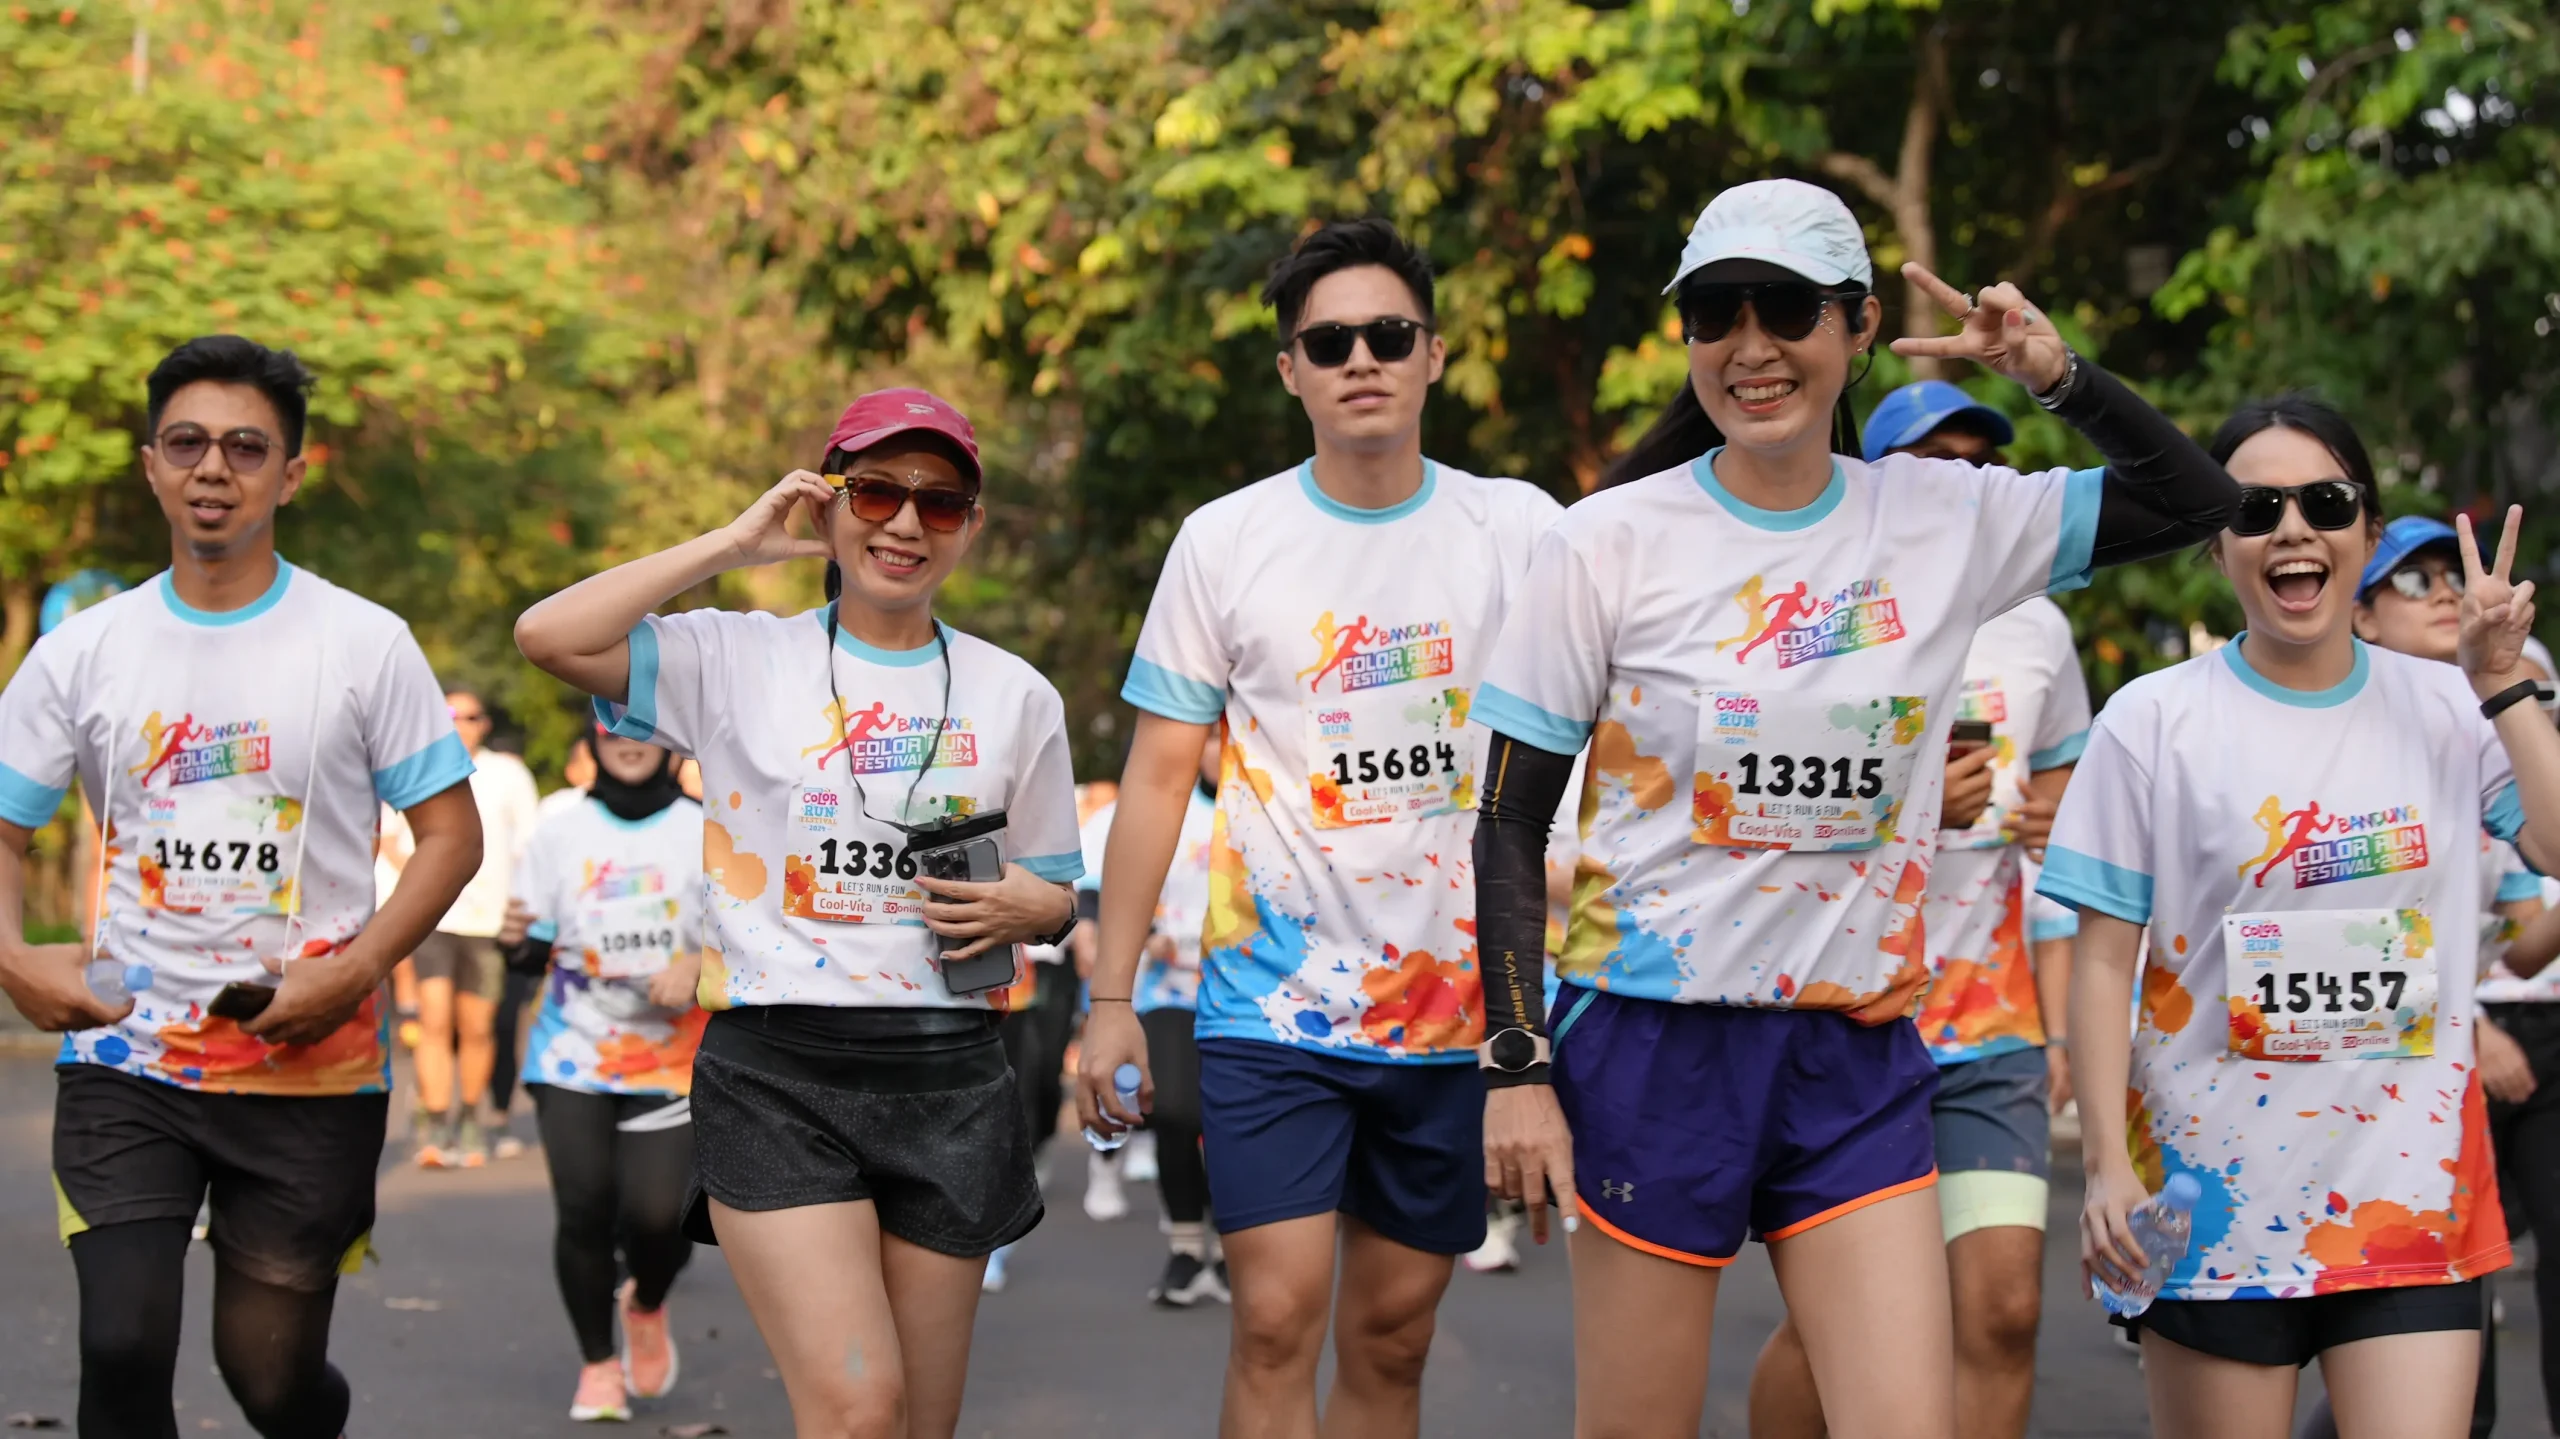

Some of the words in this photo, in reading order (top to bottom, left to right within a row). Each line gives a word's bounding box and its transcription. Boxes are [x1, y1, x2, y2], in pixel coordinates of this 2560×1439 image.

[1821, 578, 1891, 615] BANDUNG
[1379, 619, 1451, 646] BANDUNG
[1777, 611, 1851, 650] COLOR
[1852, 602, 1893, 628] RUN
[1342, 649, 1402, 675] COLOR
[1408, 641, 1448, 663] RUN
[1343, 667, 1408, 689] FESTIVAL
[1411, 659, 1449, 676] 2024
[170, 744, 225, 770] COLOR
[229, 738, 267, 758] RUN
[853, 738, 921, 757] COLOR
[855, 754, 923, 770] FESTIVAL
[1332, 741, 1455, 785] 15684
[1738, 752, 1884, 799] 13315
[803, 792, 838, 805] COLOR
[803, 805, 834, 817] RUN
[1738, 822, 1802, 838] Cool-Vita
[2338, 804, 2418, 834] BANDUNG
[155, 838, 279, 872] 14678
[820, 838, 917, 880] 1336
[2294, 838, 2368, 866] COLOR
[2375, 828, 2423, 853] RUN
[2297, 858, 2376, 883] FESTIVAL
[2380, 848, 2426, 868] 2024
[843, 882, 864, 892] LET'S
[866, 883, 881, 893] RUN
[884, 885, 889, 894] &
[891, 885, 906, 895] FUN
[820, 898, 872, 913] Cool-Vita
[1503, 951, 1527, 1024] KALIBRE
[2256, 971, 2407, 1013] 15457
